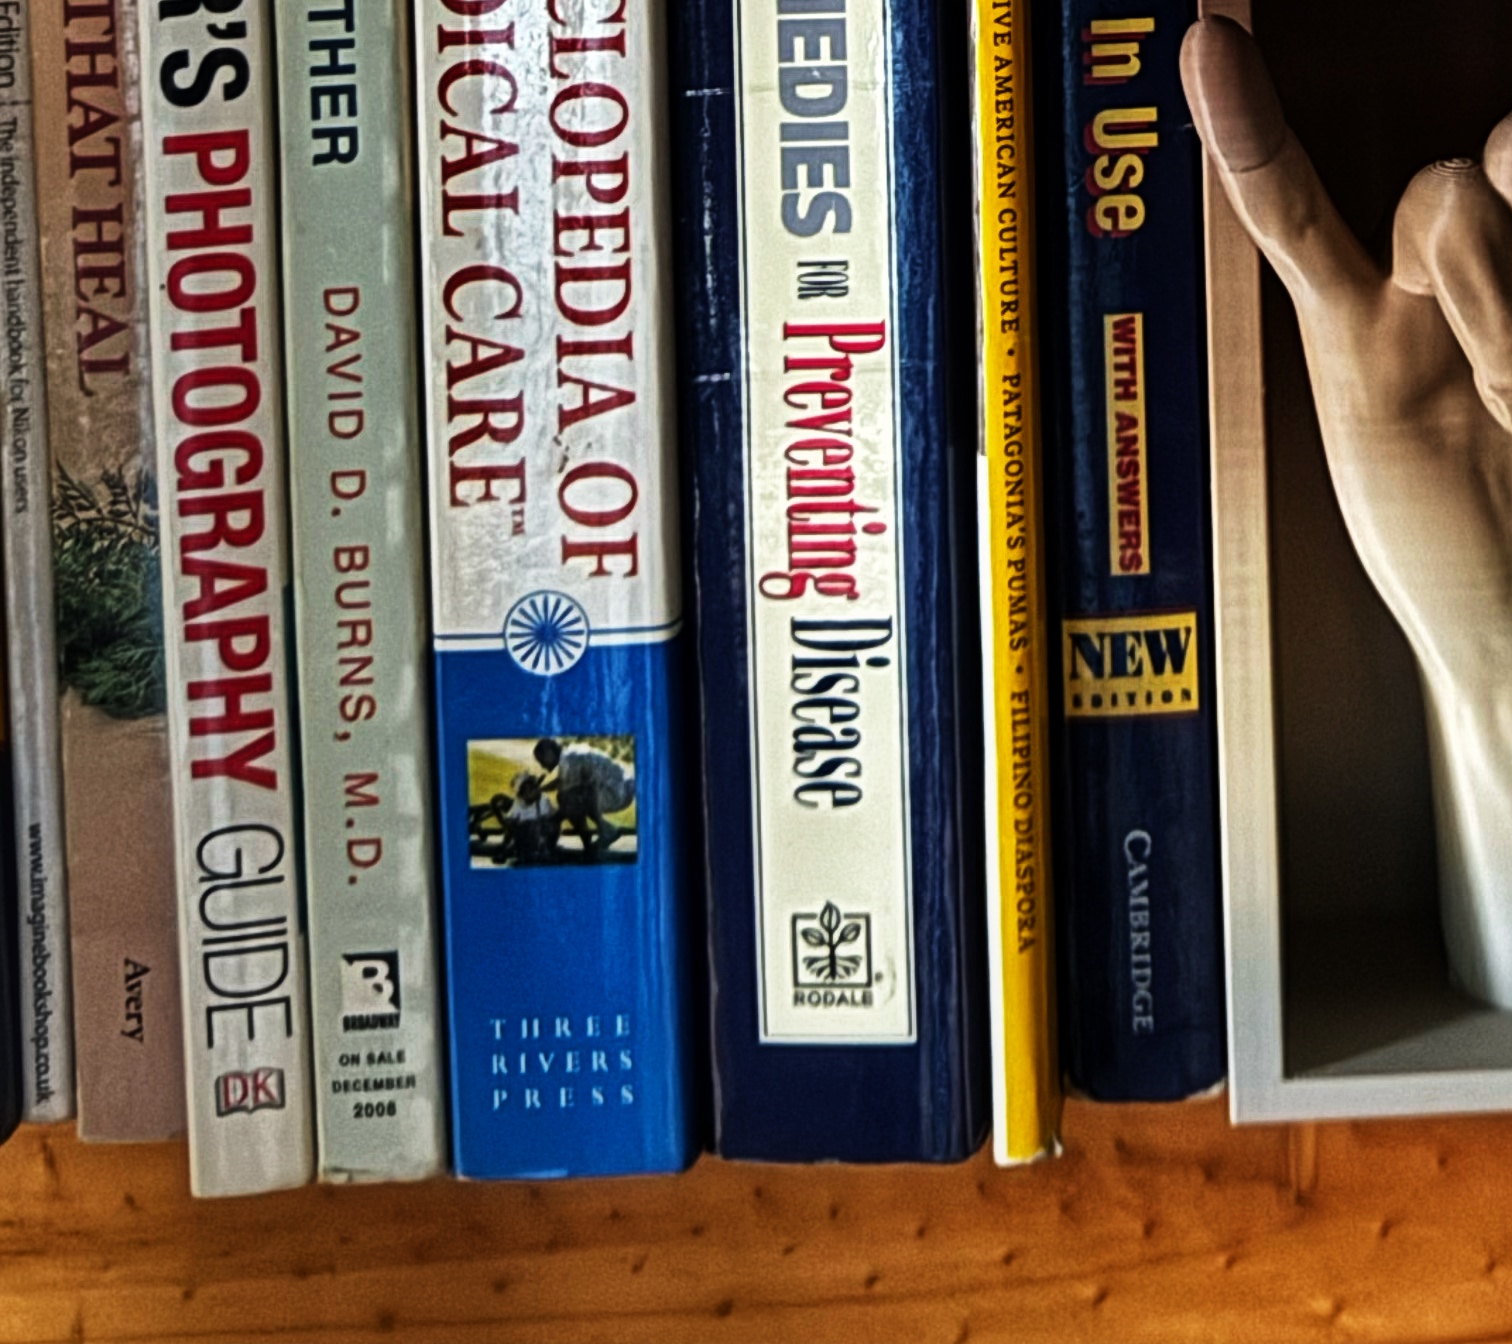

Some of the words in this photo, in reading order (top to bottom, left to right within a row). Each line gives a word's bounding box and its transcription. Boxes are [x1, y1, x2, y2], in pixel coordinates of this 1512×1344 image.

[1088, 18, 1156, 80] In
[993, 54, 1017, 201] AMERICAN
[1088, 107, 1159, 235] Use
[72, 202, 132, 398] HEAL
[795, 260, 850, 302] FOR
[997, 207, 1021, 335] CULTURE
[321, 285, 365, 440] DAVID
[1110, 315, 1139, 402] WITH
[161, 129, 279, 790] PHOTOGRAPHY
[328, 468, 367, 519] D.
[758, 320, 887, 601] Preventing
[1000, 372, 1027, 551] PATAGONIA'S
[1113, 411, 1144, 572] ANSWERS
[557, 461, 640, 581] OF
[331, 543, 377, 743] BURNS,
[1006, 558, 1031, 652] PUMAS
[1067, 626, 1192, 681] NEW
[788, 616, 893, 809] Disease
[1010, 689, 1034, 811] FILIPINO
[342, 771, 383, 889] M.D.
[1012, 816, 1037, 956] DIASPORA
[24, 822, 55, 1104] www.imaginebookshop.co.uk
[196, 823, 295, 1050] GUIDE
[1121, 828, 1155, 1033] CAMBRIDGE
[119, 956, 154, 1044] Avery
[338, 1053, 361, 1067] ON
[366, 1050, 406, 1065] SALE
[490, 1014, 631, 1041] THREE
[792, 989, 873, 1008] RODALE
[221, 1069, 279, 1109] DK
[331, 1074, 417, 1094] DECEMBER
[491, 1049, 633, 1075] RIVERS
[492, 1084, 634, 1111] PRESS
